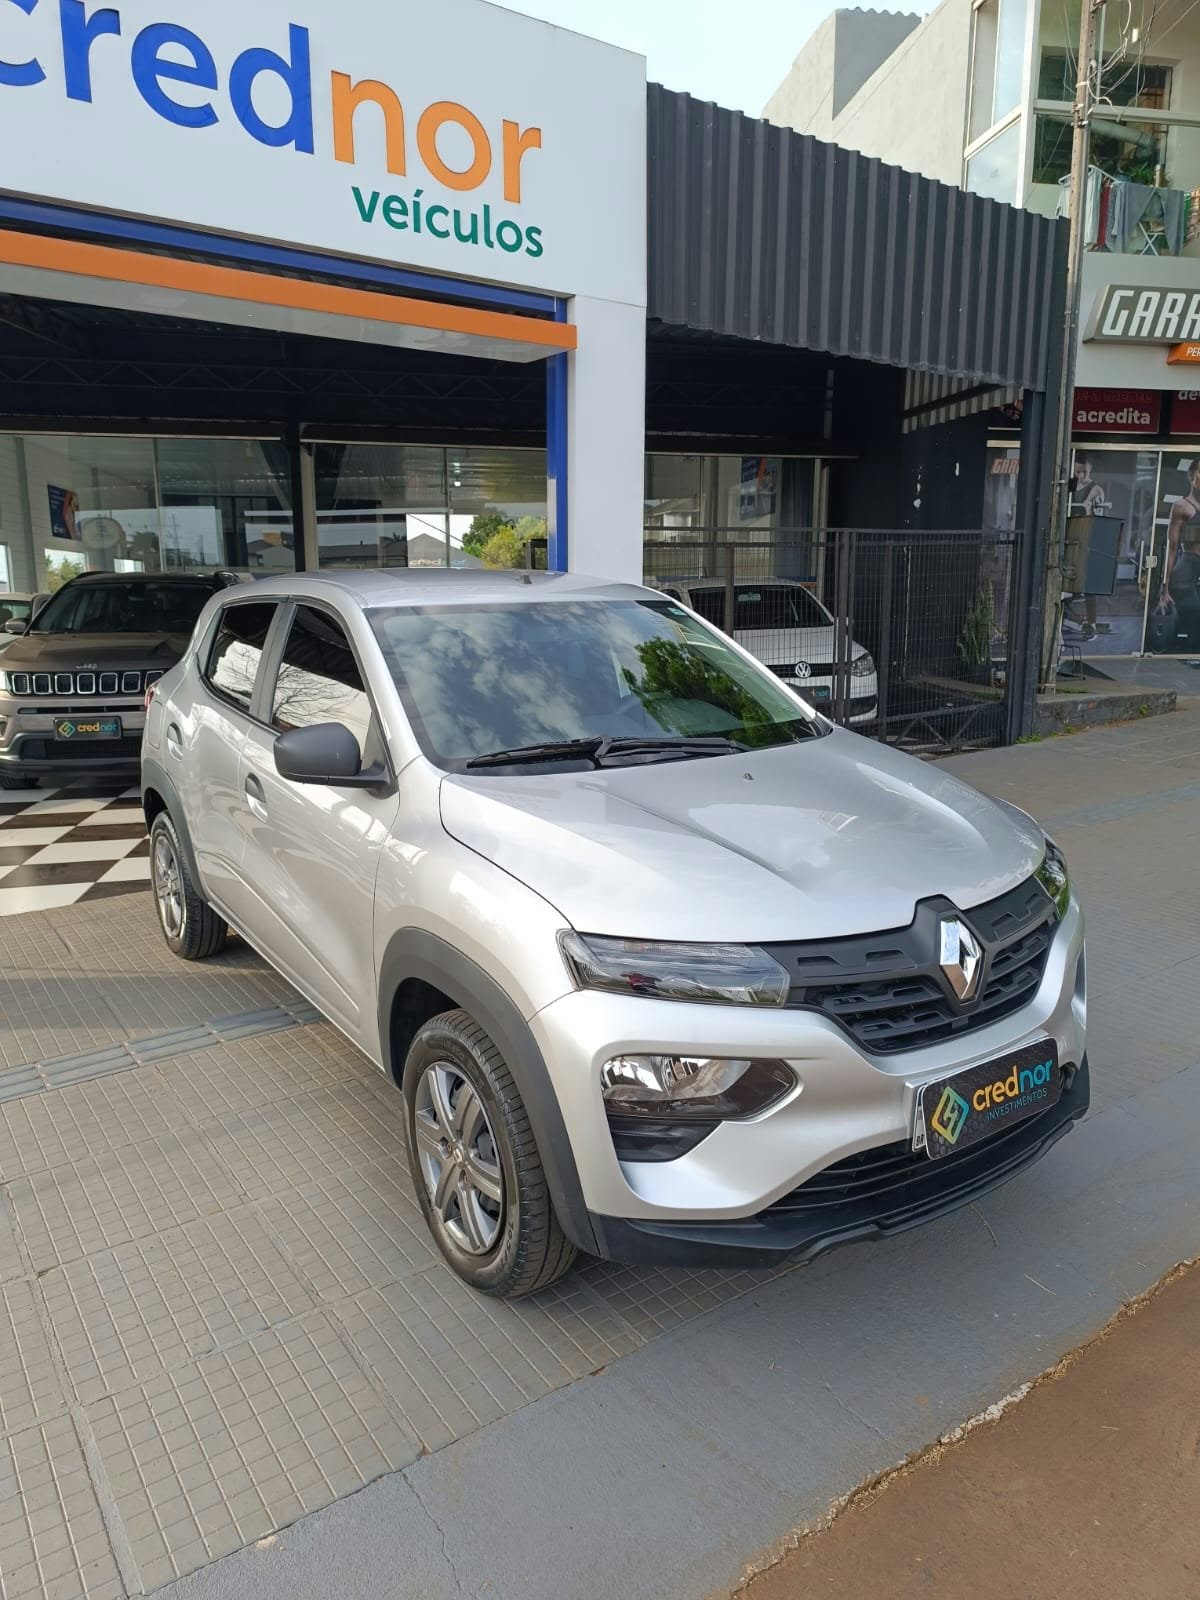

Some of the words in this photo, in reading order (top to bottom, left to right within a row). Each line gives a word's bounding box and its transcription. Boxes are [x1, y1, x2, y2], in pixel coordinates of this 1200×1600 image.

[351, 186, 544, 257] veículos
[1177, 390, 1200, 401] de
[1076, 407, 1151, 425] acredita
[972, 1059, 1053, 1111] crednor
[985, 1086, 1048, 1121] INVESTIMENTOS
